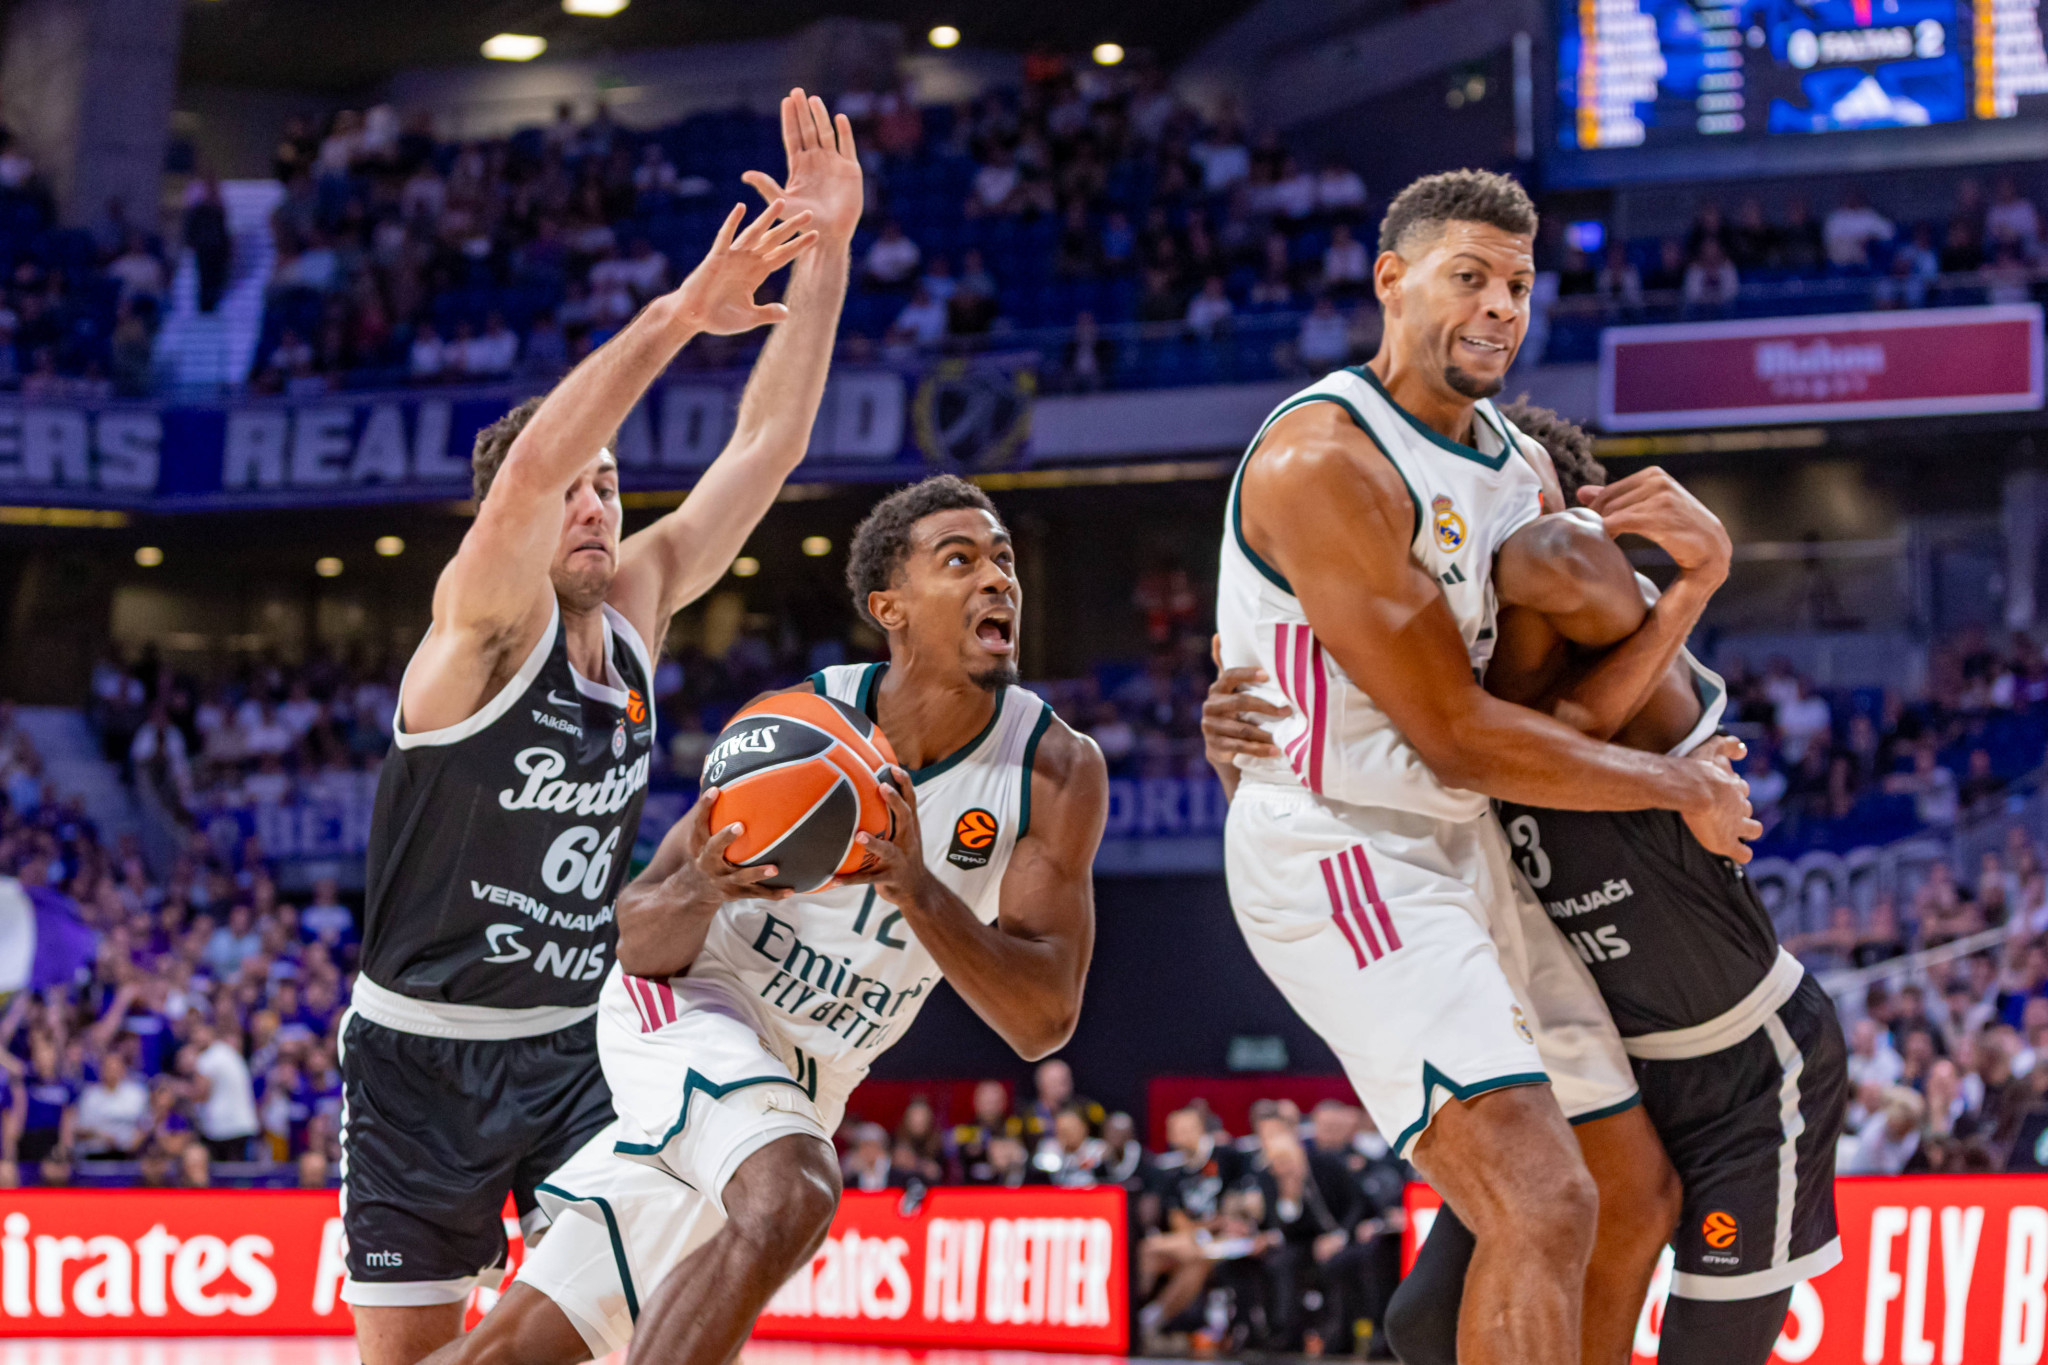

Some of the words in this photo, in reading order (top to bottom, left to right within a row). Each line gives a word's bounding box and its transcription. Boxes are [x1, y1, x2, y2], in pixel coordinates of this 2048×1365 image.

[224, 403, 469, 488] REAL
[541, 825, 621, 900] 66
[471, 880, 549, 924] VERNI
[1546, 878, 1634, 918] AVIJAČI
[533, 940, 607, 981] NIS
[760, 970, 817, 1015] FLY
[366, 1250, 403, 1267] mts
[923, 1216, 985, 1323] FLY
[985, 1216, 1112, 1326] BETTER
[1862, 1205, 1985, 1365] FLY
